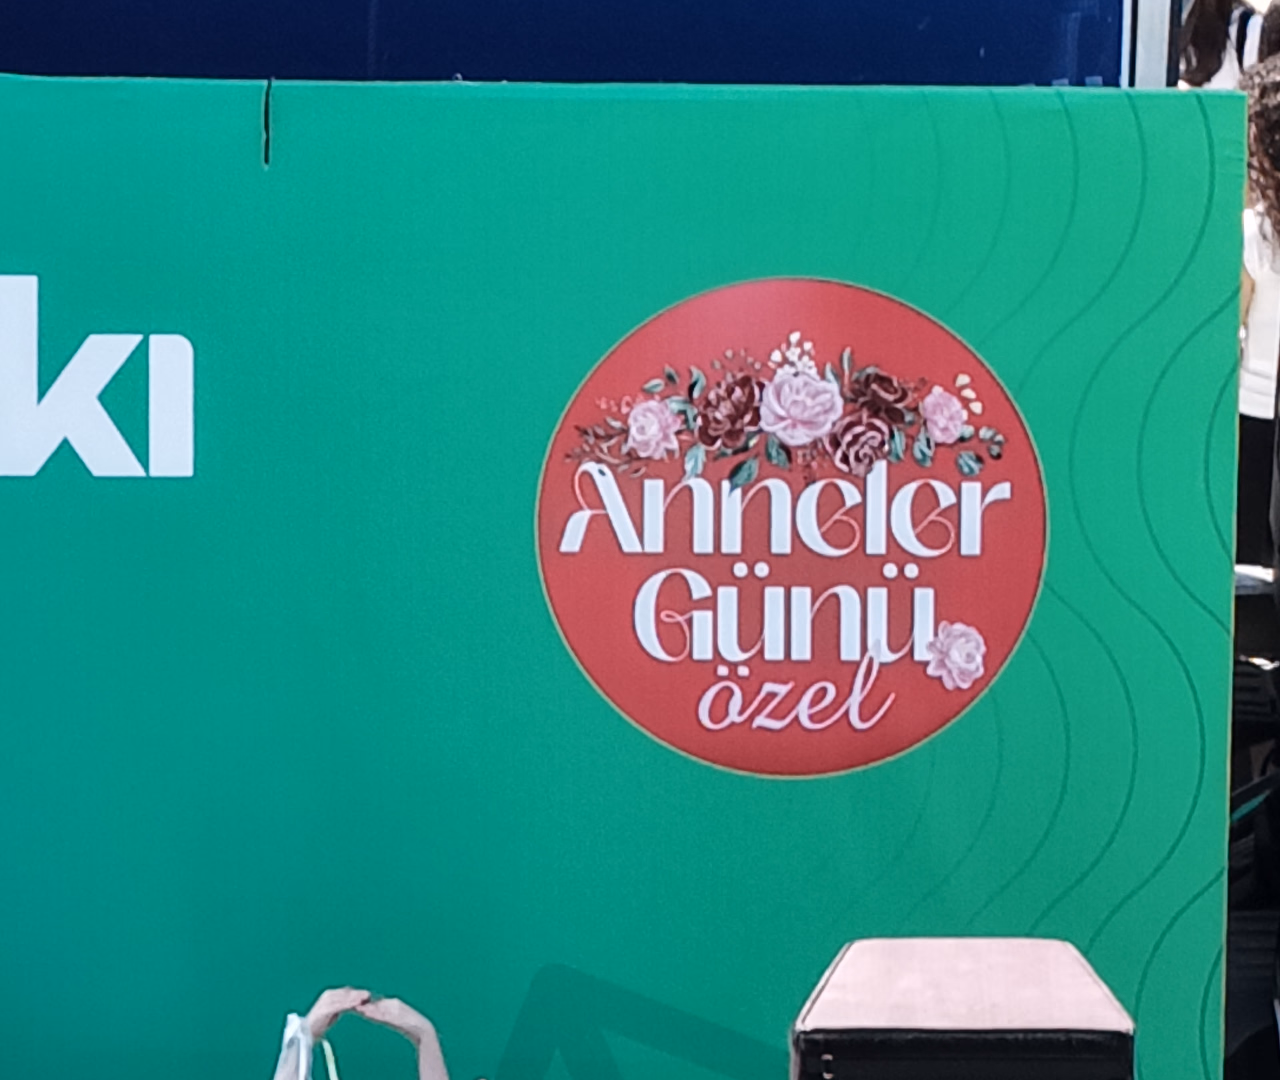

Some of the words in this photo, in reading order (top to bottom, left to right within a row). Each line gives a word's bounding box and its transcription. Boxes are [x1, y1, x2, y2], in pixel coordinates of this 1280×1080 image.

[559, 460, 1012, 558] Anneler
[633, 561, 936, 665] Günü
[697, 641, 896, 731] özel
